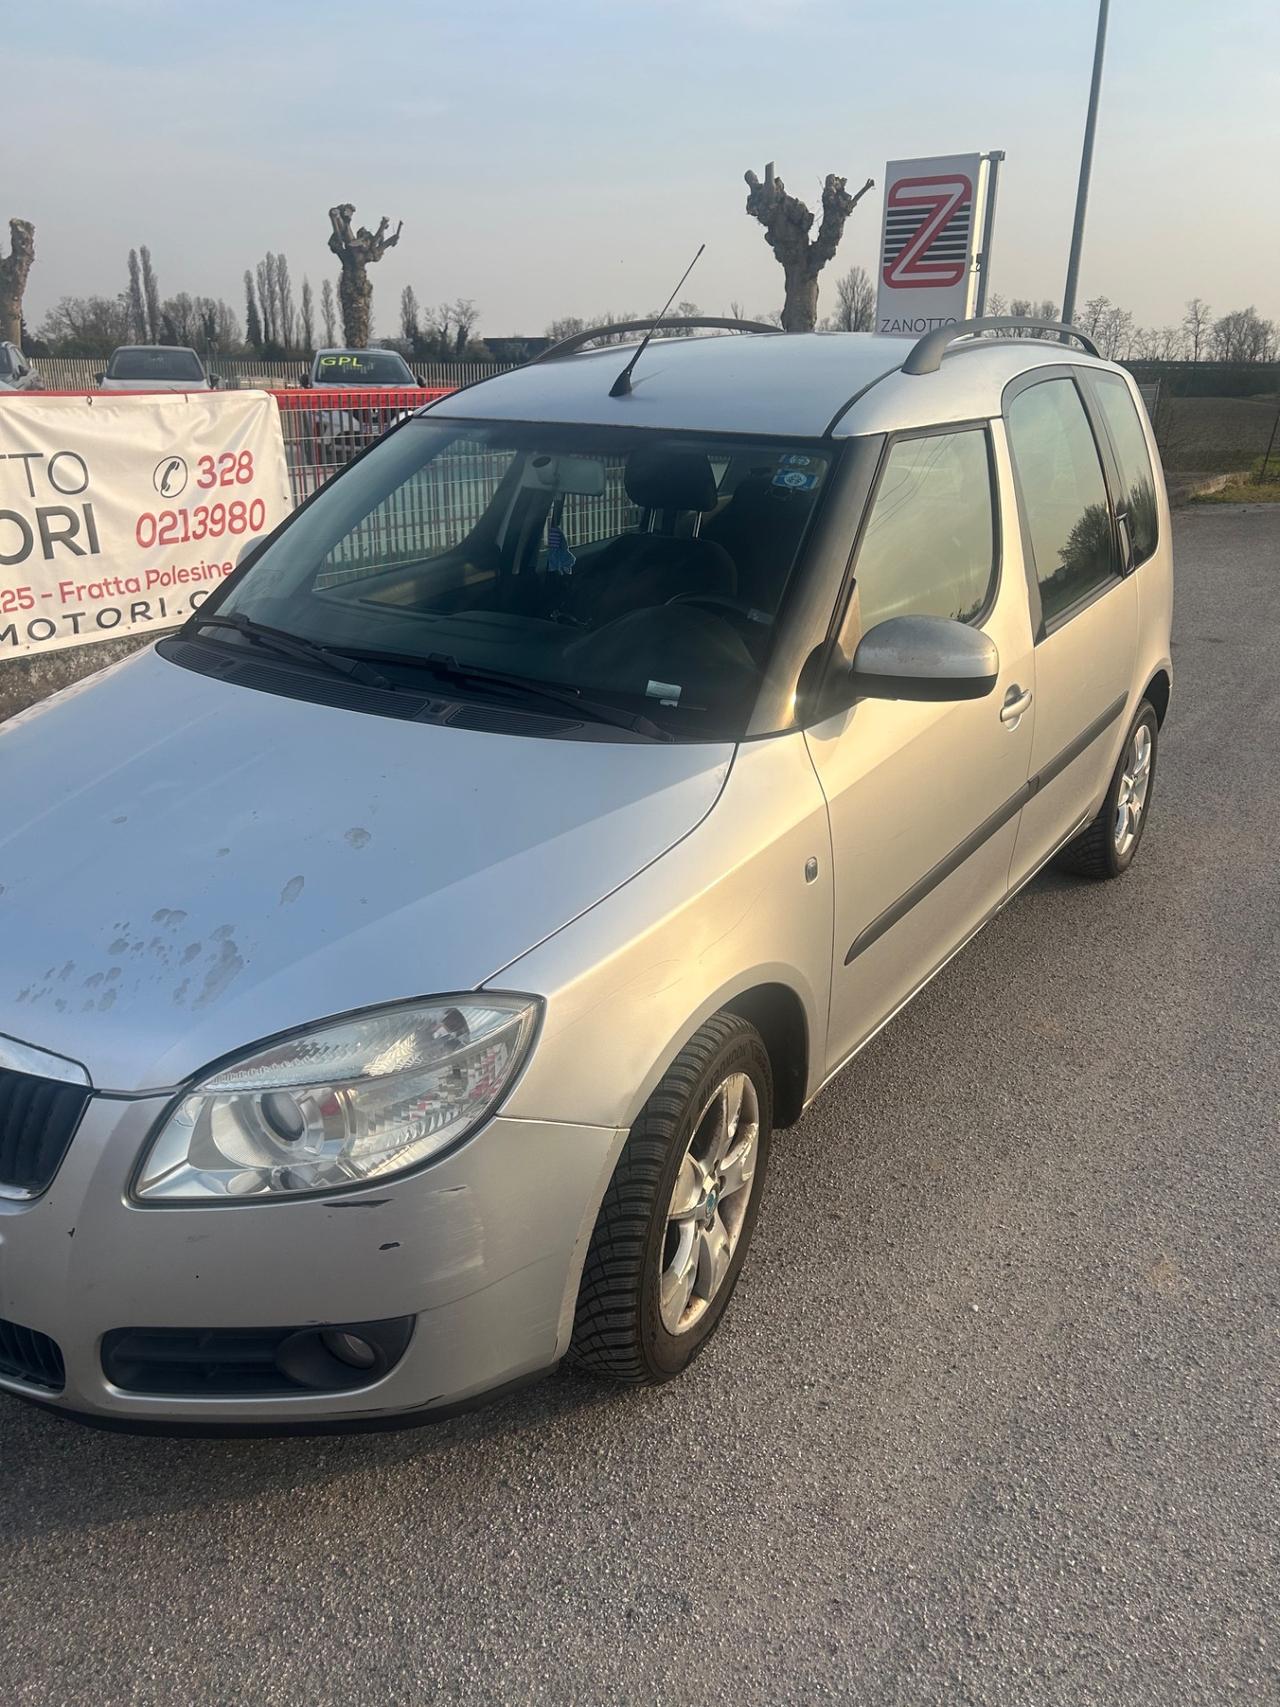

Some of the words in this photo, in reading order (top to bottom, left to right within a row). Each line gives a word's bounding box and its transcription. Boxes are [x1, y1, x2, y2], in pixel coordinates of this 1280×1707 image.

[321, 356, 363, 366] GPL
[0, 451, 89, 497] TO
[196, 450, 254, 489] 328
[136, 498, 265, 548] 0213980
[0, 586, 35, 614] 25
[59, 576, 141, 604] Fratta
[145, 560, 233, 590] Polesine
